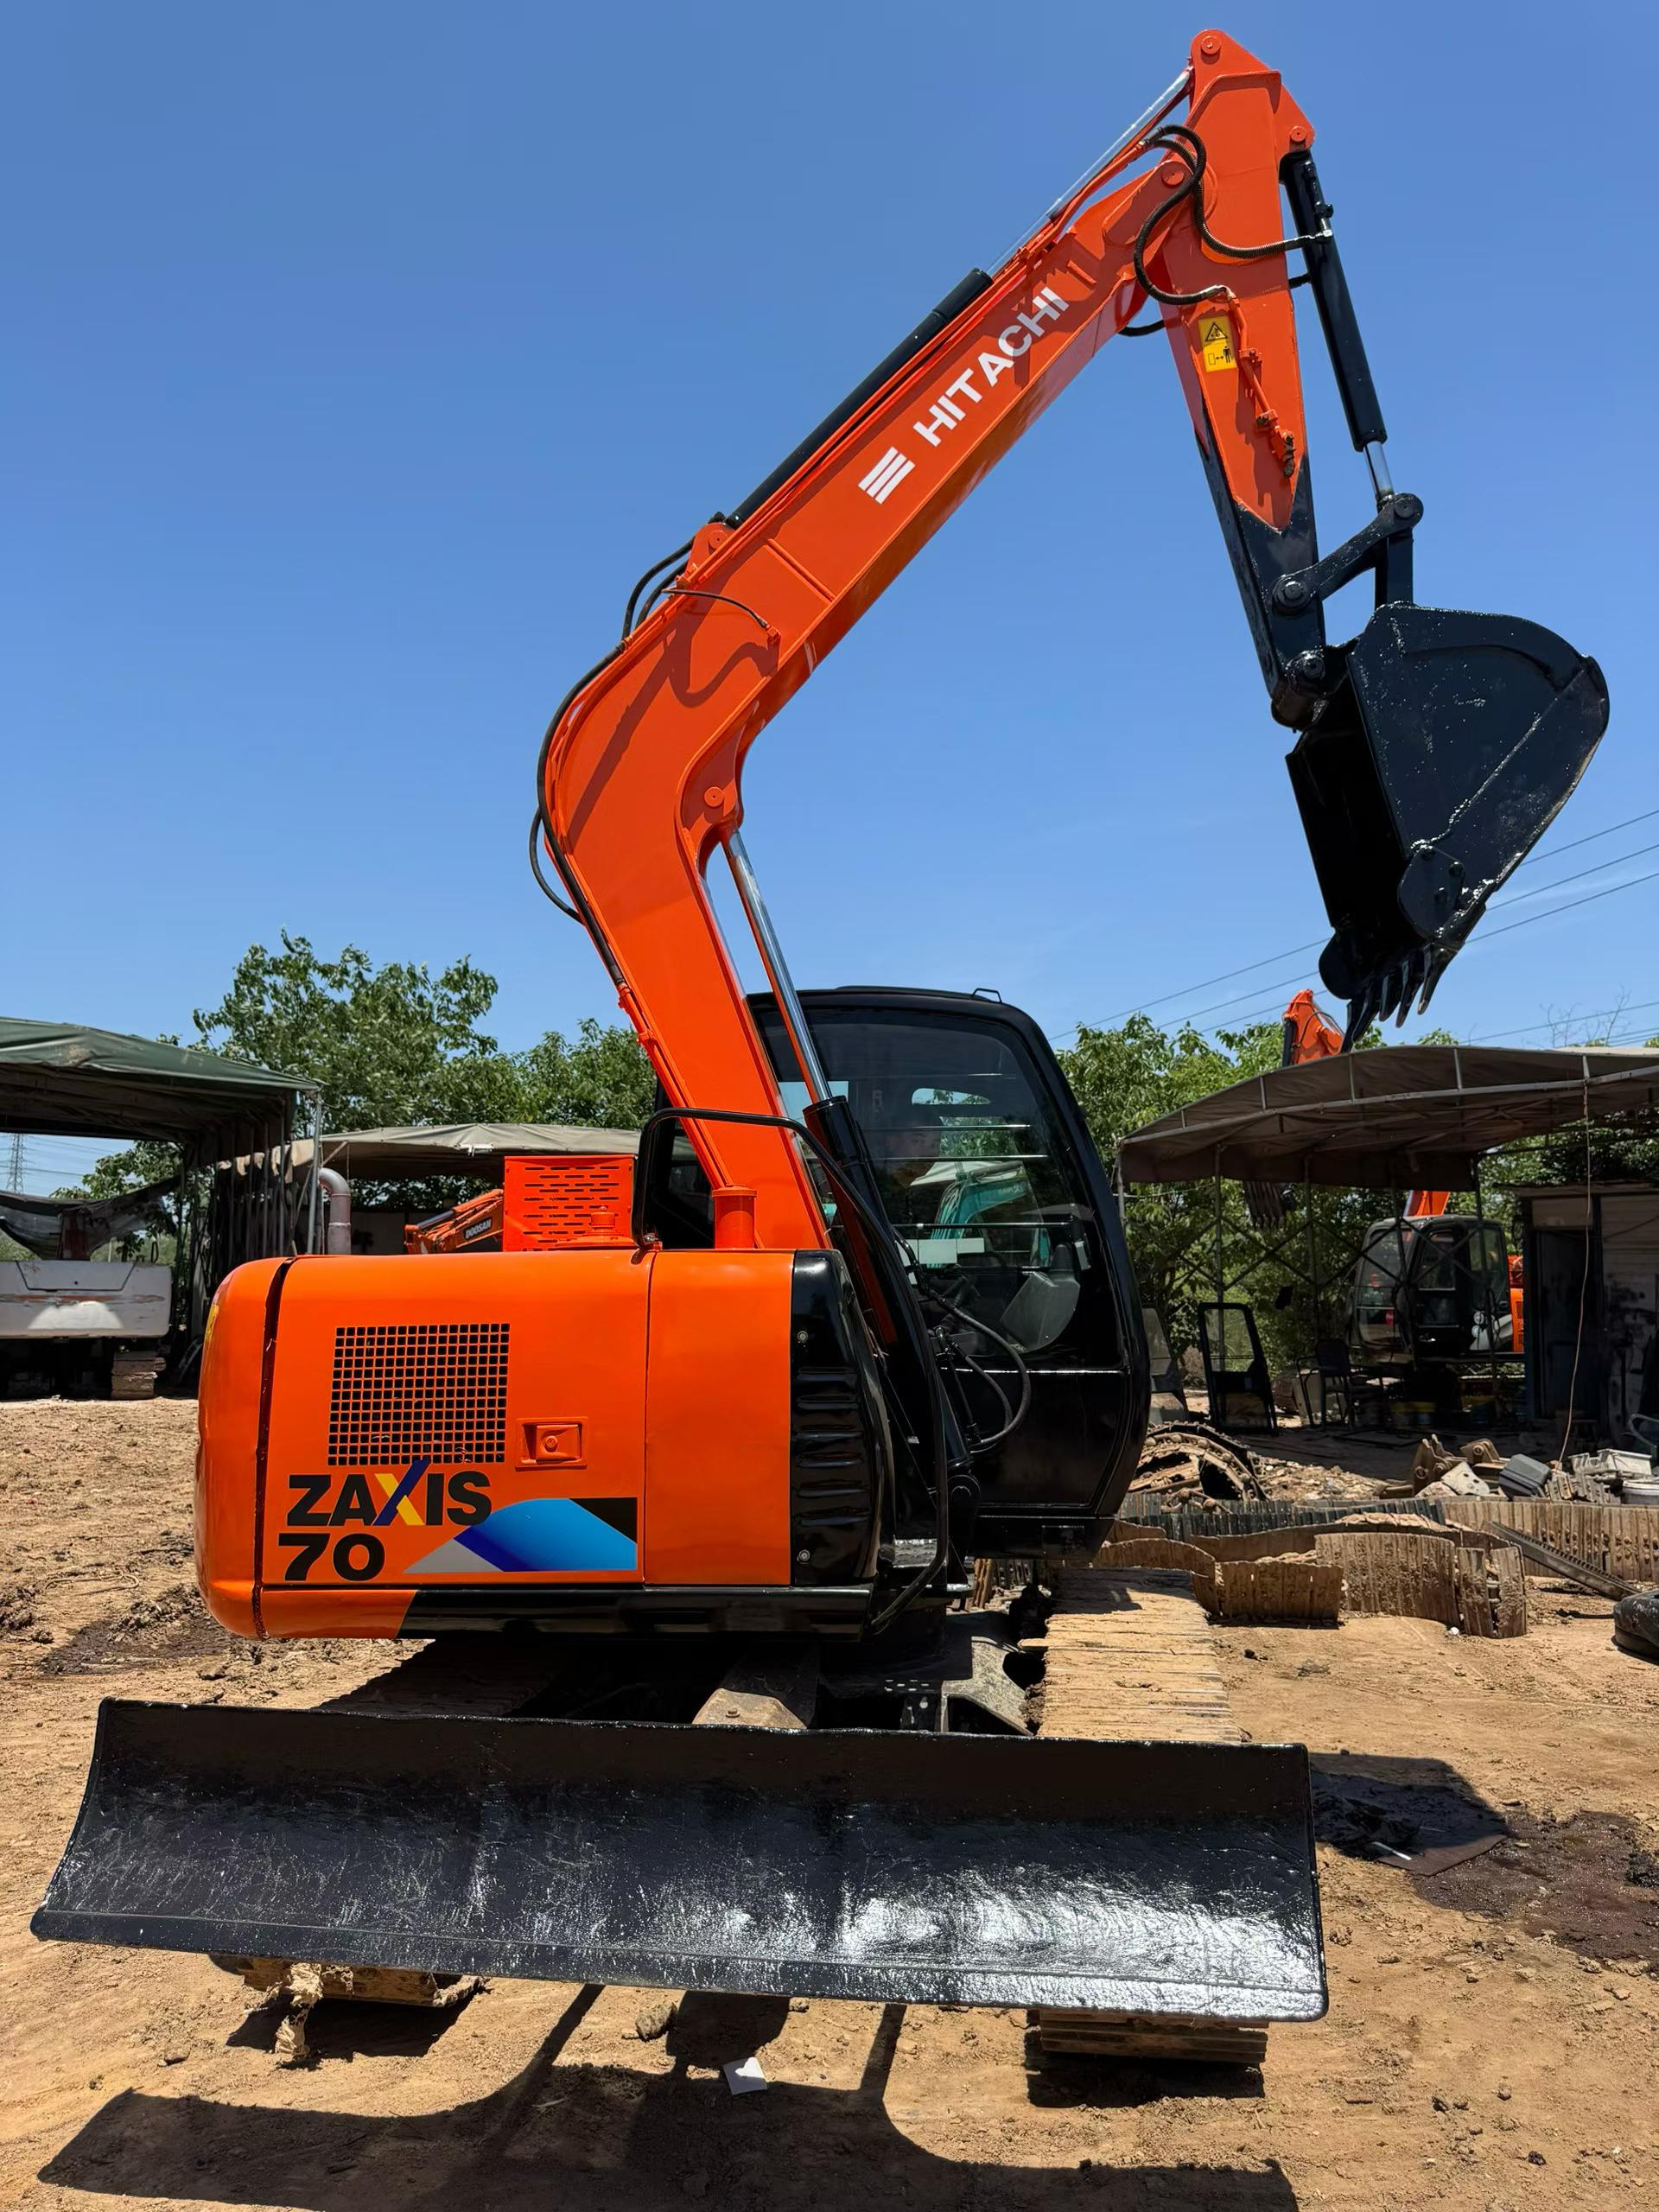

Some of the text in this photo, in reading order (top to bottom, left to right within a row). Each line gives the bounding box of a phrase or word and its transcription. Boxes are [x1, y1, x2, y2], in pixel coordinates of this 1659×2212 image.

[912, 286, 1070, 447] HITACHI
[286, 1459, 493, 1527] ZAXIS
[277, 1533, 386, 1581] 70
